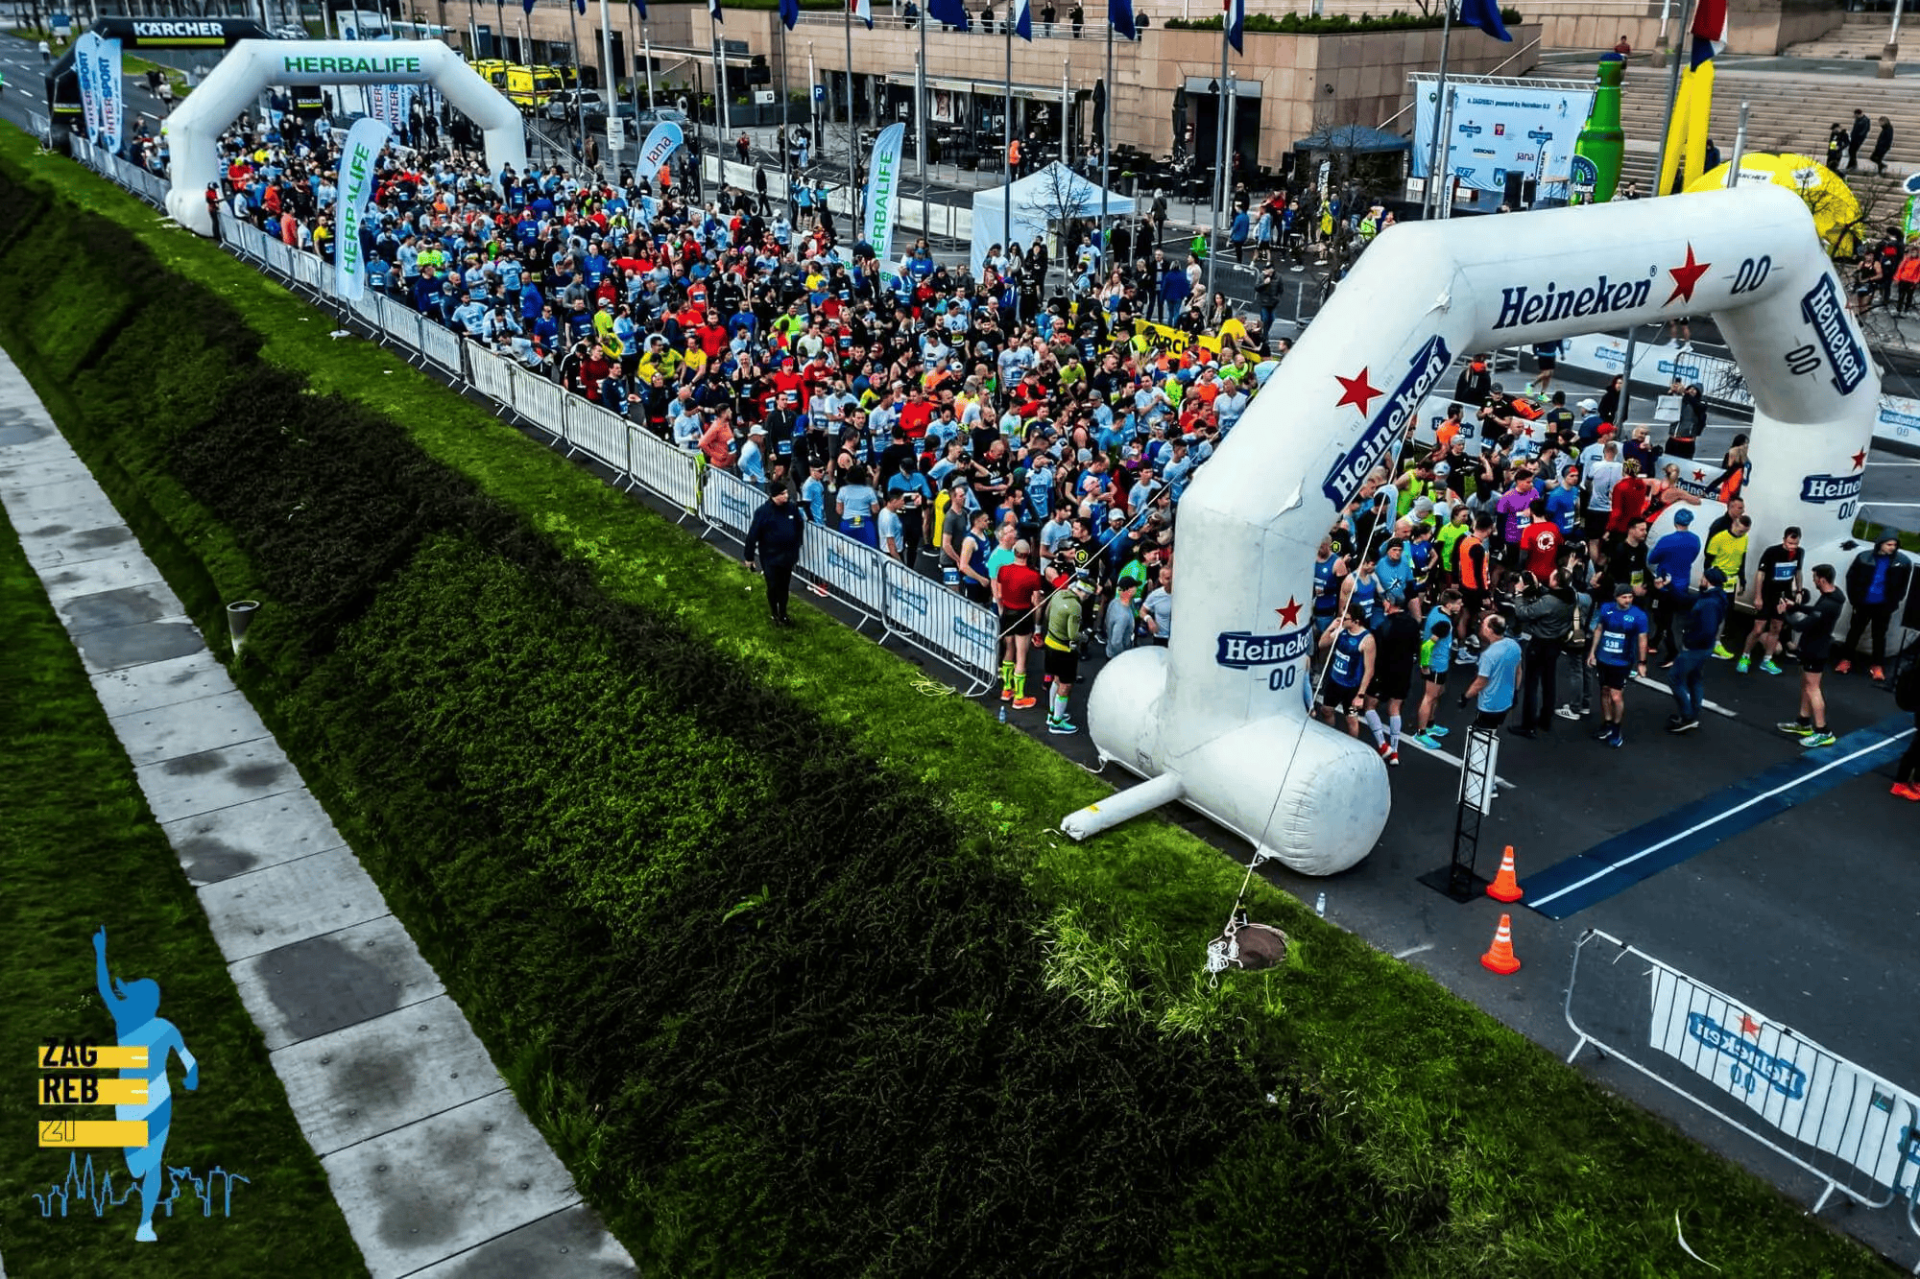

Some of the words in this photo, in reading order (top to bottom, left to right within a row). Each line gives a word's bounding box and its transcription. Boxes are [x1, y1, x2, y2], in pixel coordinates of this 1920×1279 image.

[132, 21, 223, 37] KÄRCHER
[284, 56, 420, 73] HERBALIFE
[343, 142, 370, 274] HERBALIFE
[1810, 281, 1860, 386] Heineken
[1332, 356, 1444, 502] Heineken
